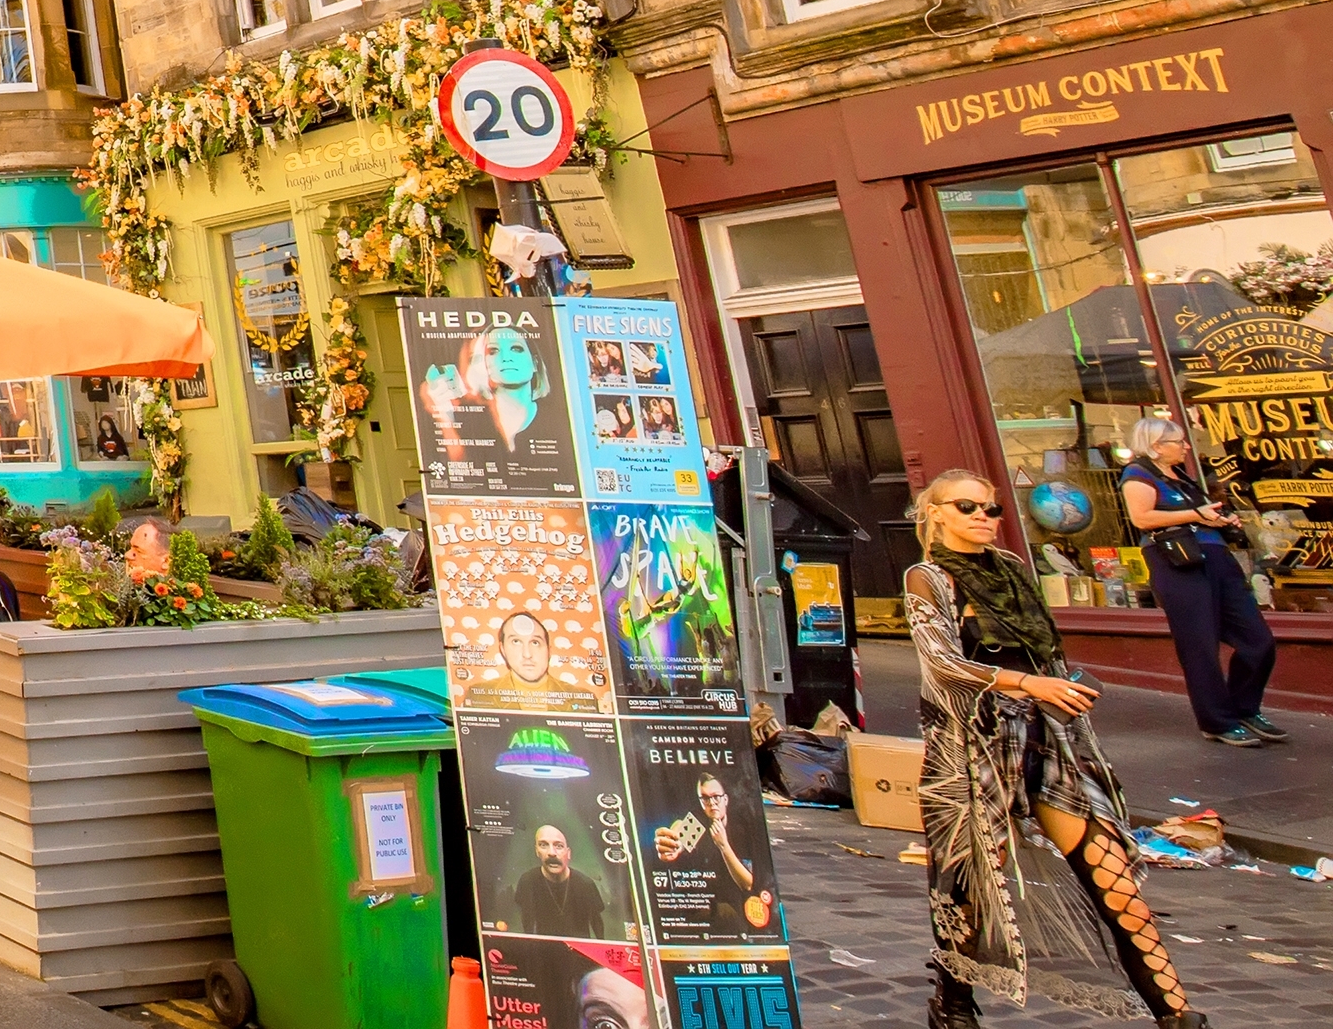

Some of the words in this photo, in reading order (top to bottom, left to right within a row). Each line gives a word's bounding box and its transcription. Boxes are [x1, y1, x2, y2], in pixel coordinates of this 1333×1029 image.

[915, 81, 1053, 145] MUSEUM
[1058, 47, 1230, 102] CONTEXT
[463, 85, 556, 145] 20
[1042, 113, 1068, 125] HARRY
[1069, 111, 1099, 123] POTTER
[285, 173, 320, 192] haggis
[324, 161, 345, 179] and
[349, 153, 387, 174] whisky
[417, 311, 540, 328] HEDDA
[1234, 306, 1253, 316] THE
[573, 314, 616, 336] FIRE
[619, 316, 673, 338] SIGNS
[1205, 321, 1326, 352] CURIOSITIES
[1243, 334, 1323, 355] CURIOUS
[255, 366, 315, 385] arcade
[1213, 459, 1240, 478] BUILT
[680, 473, 693, 483] 33
[1279, 481, 1308, 493] HARRY
[470, 508, 505, 521] Phil
[508, 509, 544, 521] Ellis
[433, 522, 585, 554] Hedgehog
[614, 514, 698, 545] BRAVE
[704, 691, 736, 702] CIRCUS
[718, 701, 738, 710] HUB
[508, 728, 571, 753] ALIEN
[652, 736, 695, 744] CAMERON
[649, 749, 735, 765] BELIEVE
[370, 803, 394, 811] PRIVATE
[376, 849, 397, 858] PUBLIC
[397, 848, 408, 856] USE
[653, 876, 668, 888] 67
[697, 963, 711, 974] 6TH
[711, 963, 727, 974] SELL
[727, 963, 741, 974] OUT
[741, 963, 758, 974] YEAR
[493, 995, 541, 1015] Utter
[677, 986, 793, 1029] ELVIS
